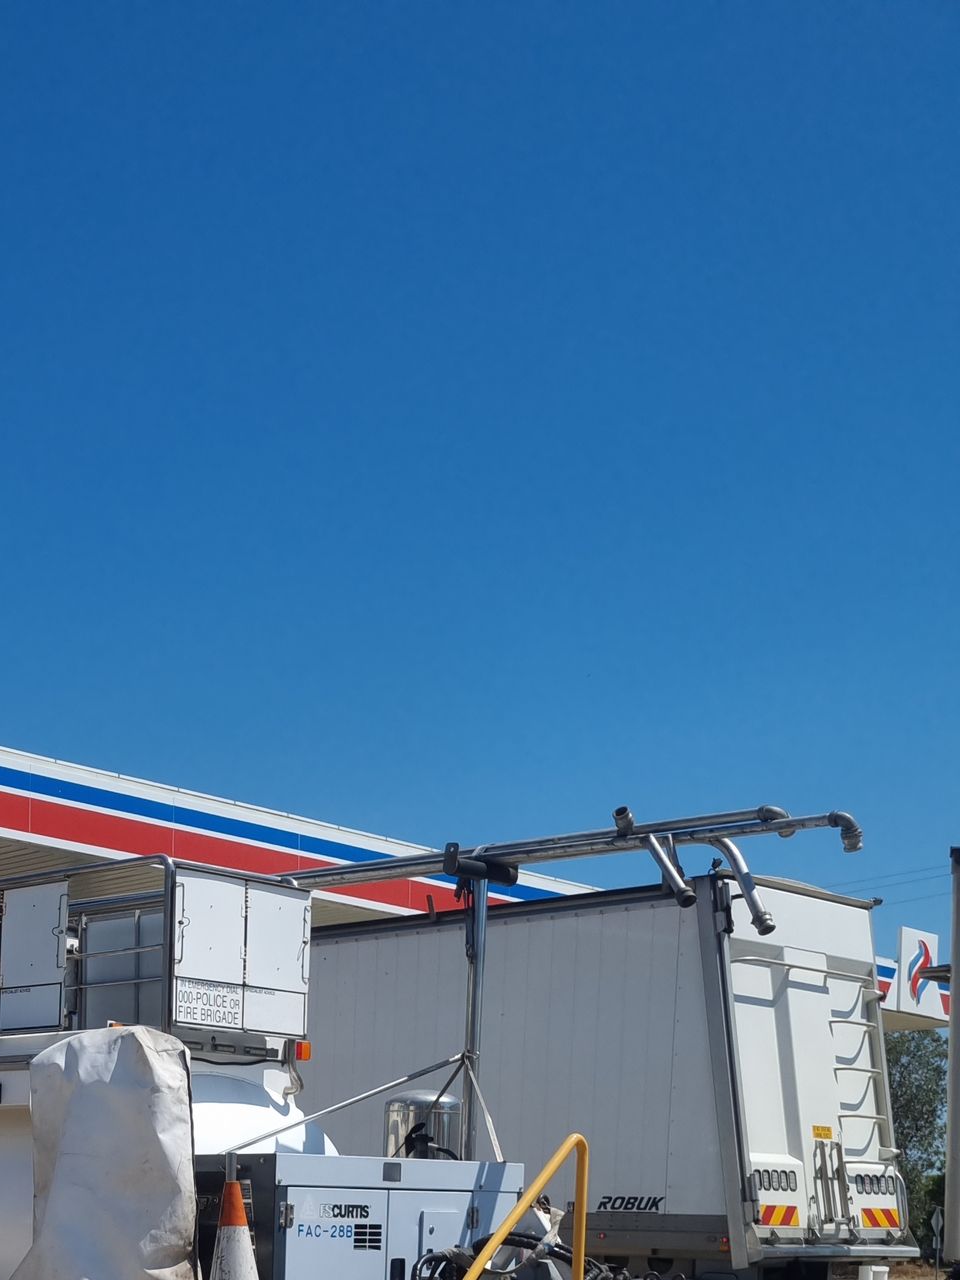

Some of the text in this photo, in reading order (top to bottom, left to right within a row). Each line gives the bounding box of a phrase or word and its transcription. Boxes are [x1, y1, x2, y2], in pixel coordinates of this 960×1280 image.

[179, 979, 240, 994] IN EMERGENCY DIAL
[178, 990, 240, 1010] 000-POLICE OR
[178, 1005, 239, 1025] FIRE BRIGADE
[597, 1196, 665, 1211] ROBUK
[297, 1224, 353, 1238] FAC-28B
